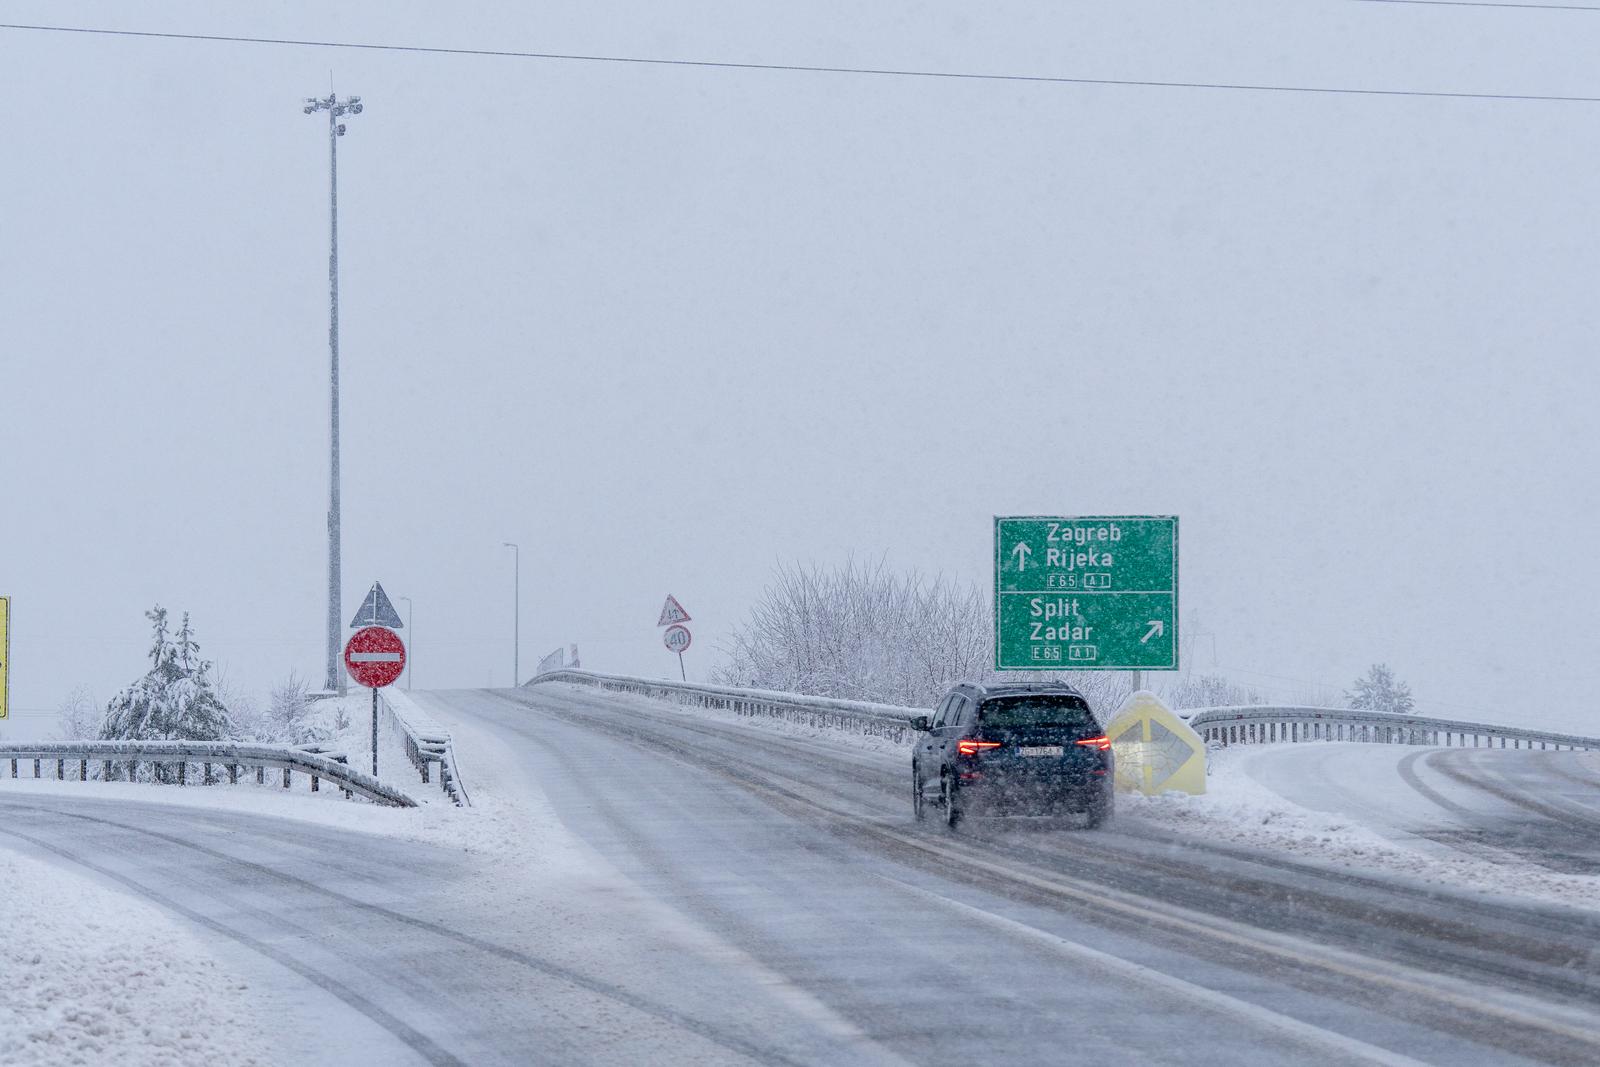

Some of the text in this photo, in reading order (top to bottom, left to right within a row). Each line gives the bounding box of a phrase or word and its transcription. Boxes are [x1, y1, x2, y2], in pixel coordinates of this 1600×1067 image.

[1047, 522, 1121, 546] Zagreb
[1046, 548, 1112, 571] Rijeka
[1030, 598, 1080, 621] Split
[669, 630, 686, 646] 40
[1030, 622, 1093, 641] Zadar
